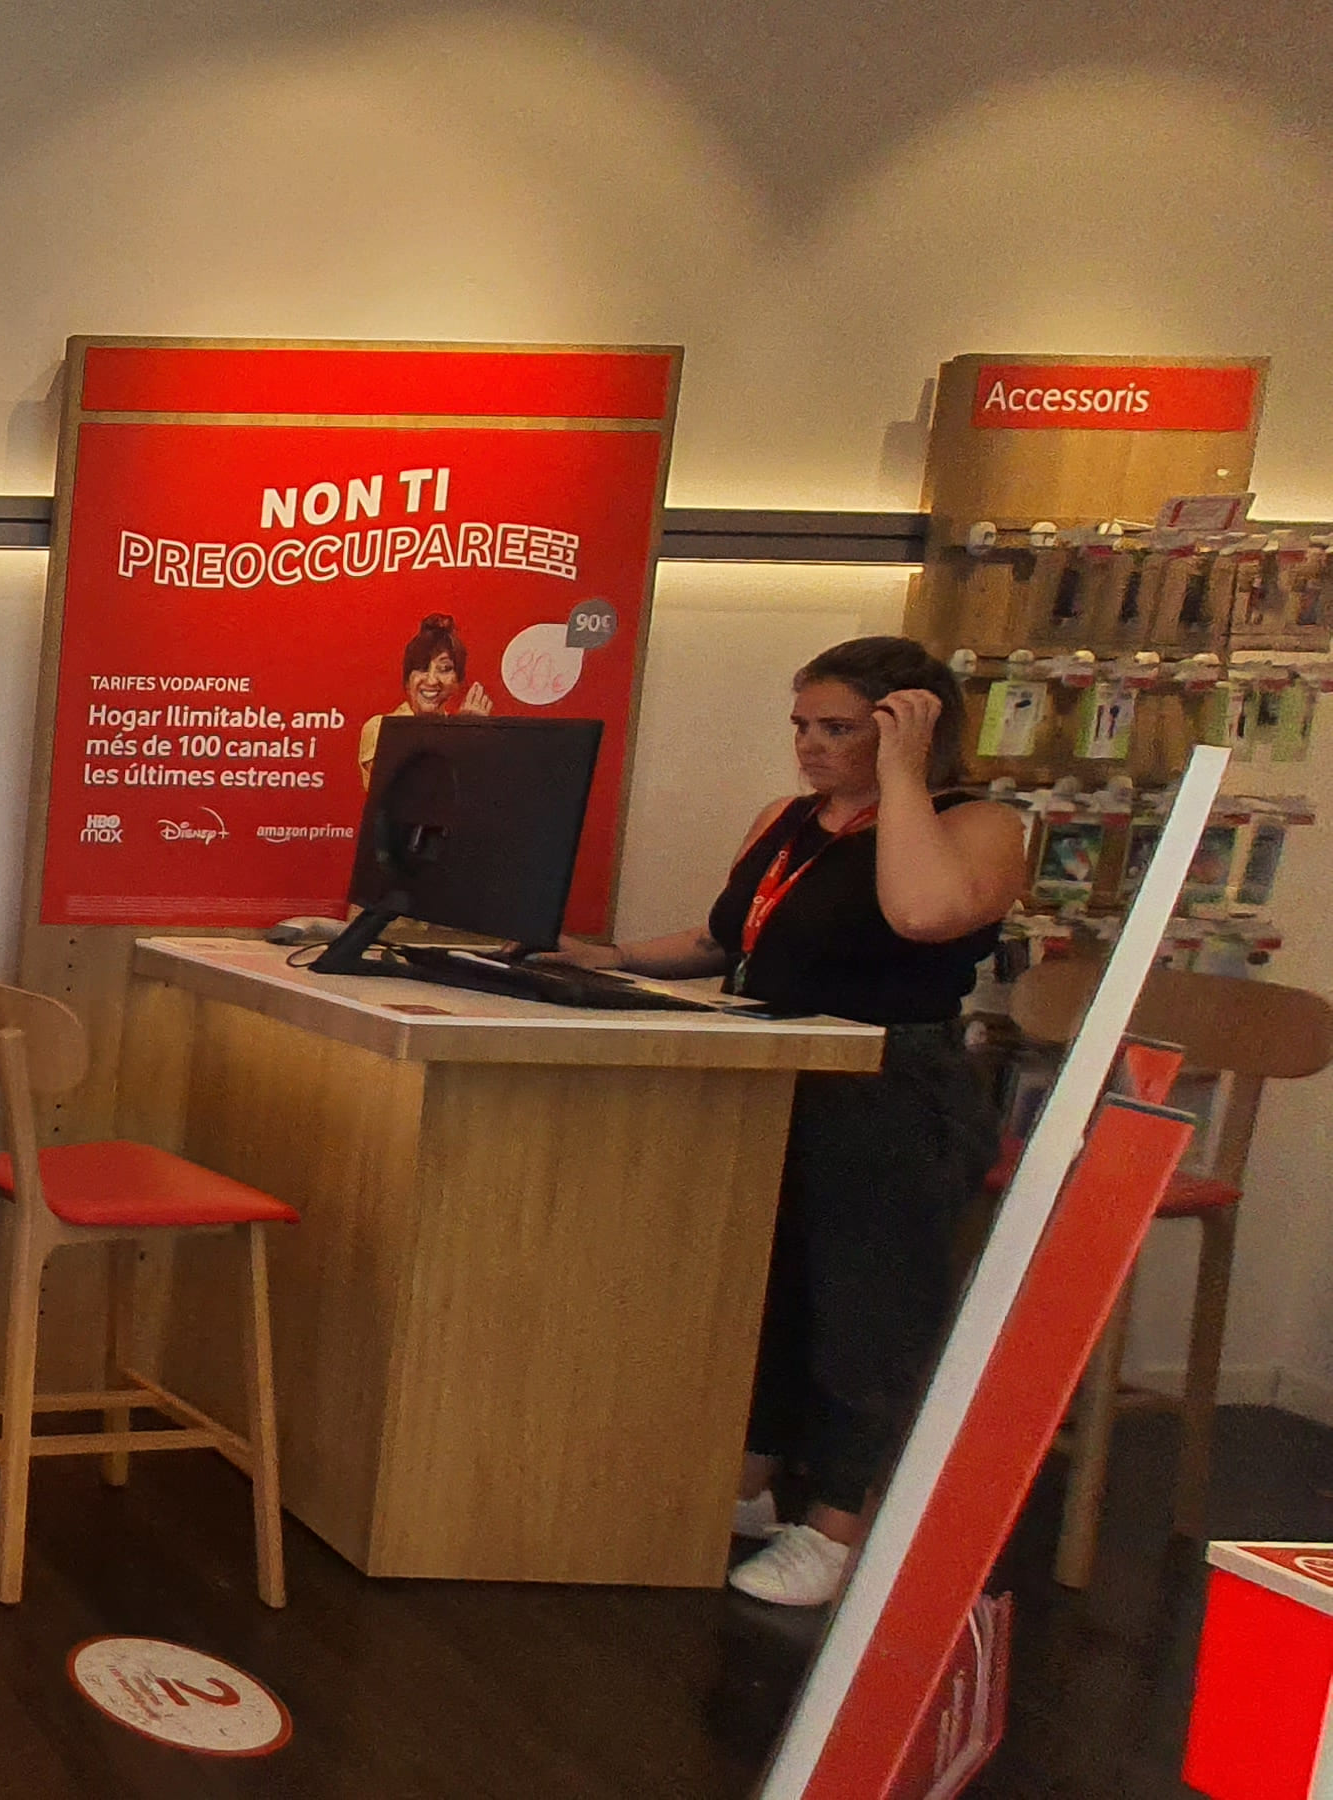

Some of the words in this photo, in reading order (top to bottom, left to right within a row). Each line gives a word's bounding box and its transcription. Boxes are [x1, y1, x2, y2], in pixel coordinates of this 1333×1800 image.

[984, 380, 1150, 413] Accessoris
[260, 474, 383, 529] NON
[399, 467, 450, 513] TI
[575, 613, 612, 633] 90€
[90, 675, 156, 691] TARIFES
[159, 676, 250, 692] VODAFONE
[88, 704, 162, 732] Hogar
[165, 705, 286, 730] Ilimitable,
[291, 707, 345, 730] amb
[85, 733, 138, 756] més
[141, 735, 172, 756] de
[178, 735, 221, 757] 100
[225, 736, 304, 759] canals
[308, 737, 317, 759] i
[84, 763, 119, 786] les
[124, 762, 215, 787] últimes
[219, 767, 325, 788] estrenes
[86, 814, 120, 829] HBO
[256, 825, 307, 841] amazon
[309, 823, 354, 841] prime
[80, 828, 123, 843] max
